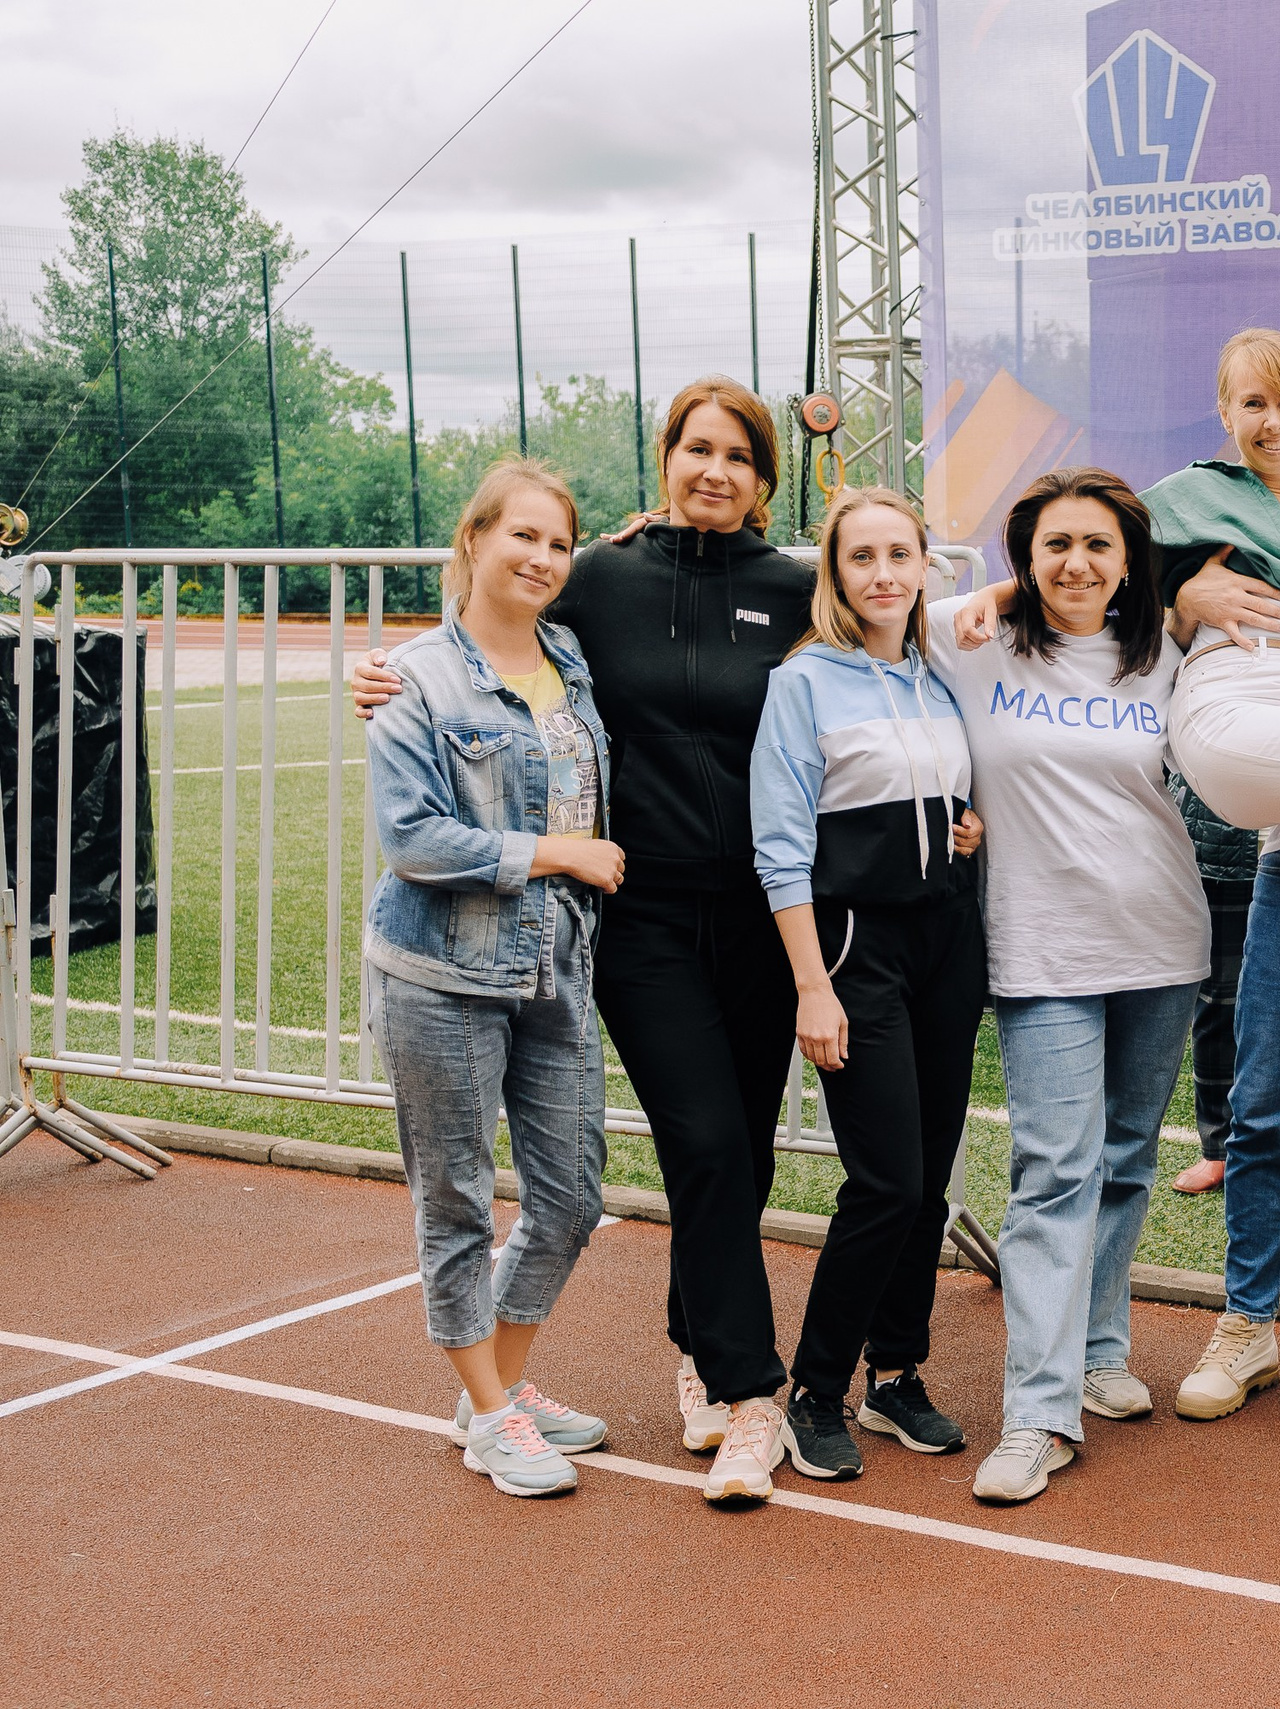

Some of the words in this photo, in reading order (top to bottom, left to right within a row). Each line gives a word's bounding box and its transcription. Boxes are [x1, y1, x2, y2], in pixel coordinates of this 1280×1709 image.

[1031, 182, 1264, 219] ЧЕЛЯБИНСКИЙ
[998, 221, 1175, 254] ЦИНКОВЫЙ
[736, 608, 770, 626] PUMA
[990, 681, 1161, 735] МАССИВ
